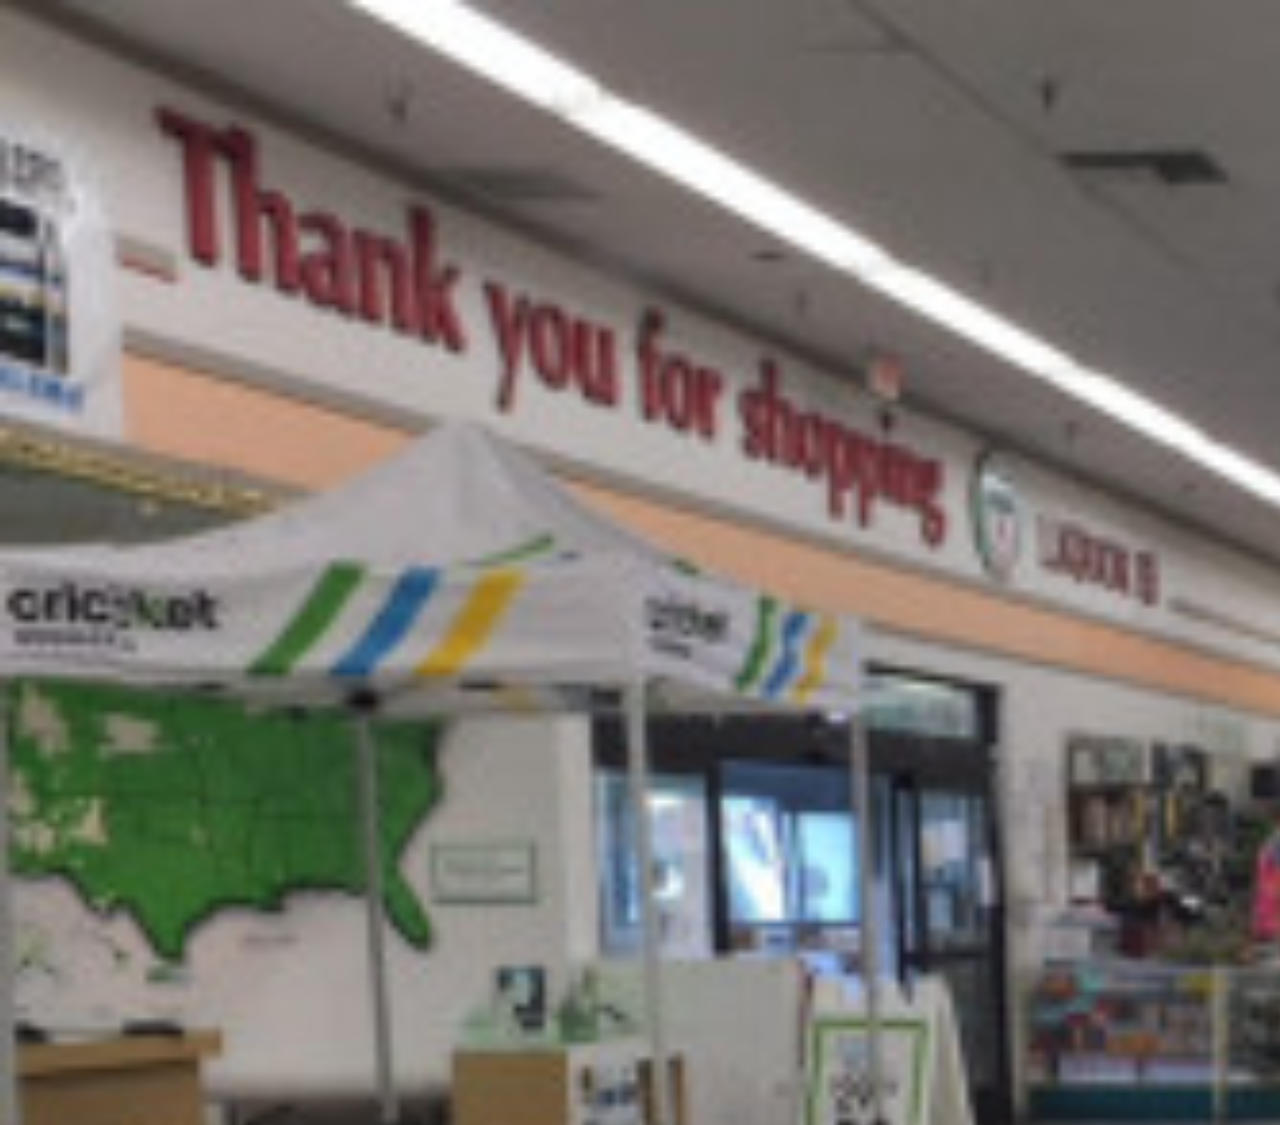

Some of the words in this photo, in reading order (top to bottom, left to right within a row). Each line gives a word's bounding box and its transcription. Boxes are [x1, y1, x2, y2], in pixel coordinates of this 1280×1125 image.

[154, 104, 466, 356] Thank
[483, 278, 620, 412] you
[637, 307, 720, 442] for
[738, 357, 948, 548] shopping
[7, 582, 218, 630] cricket
